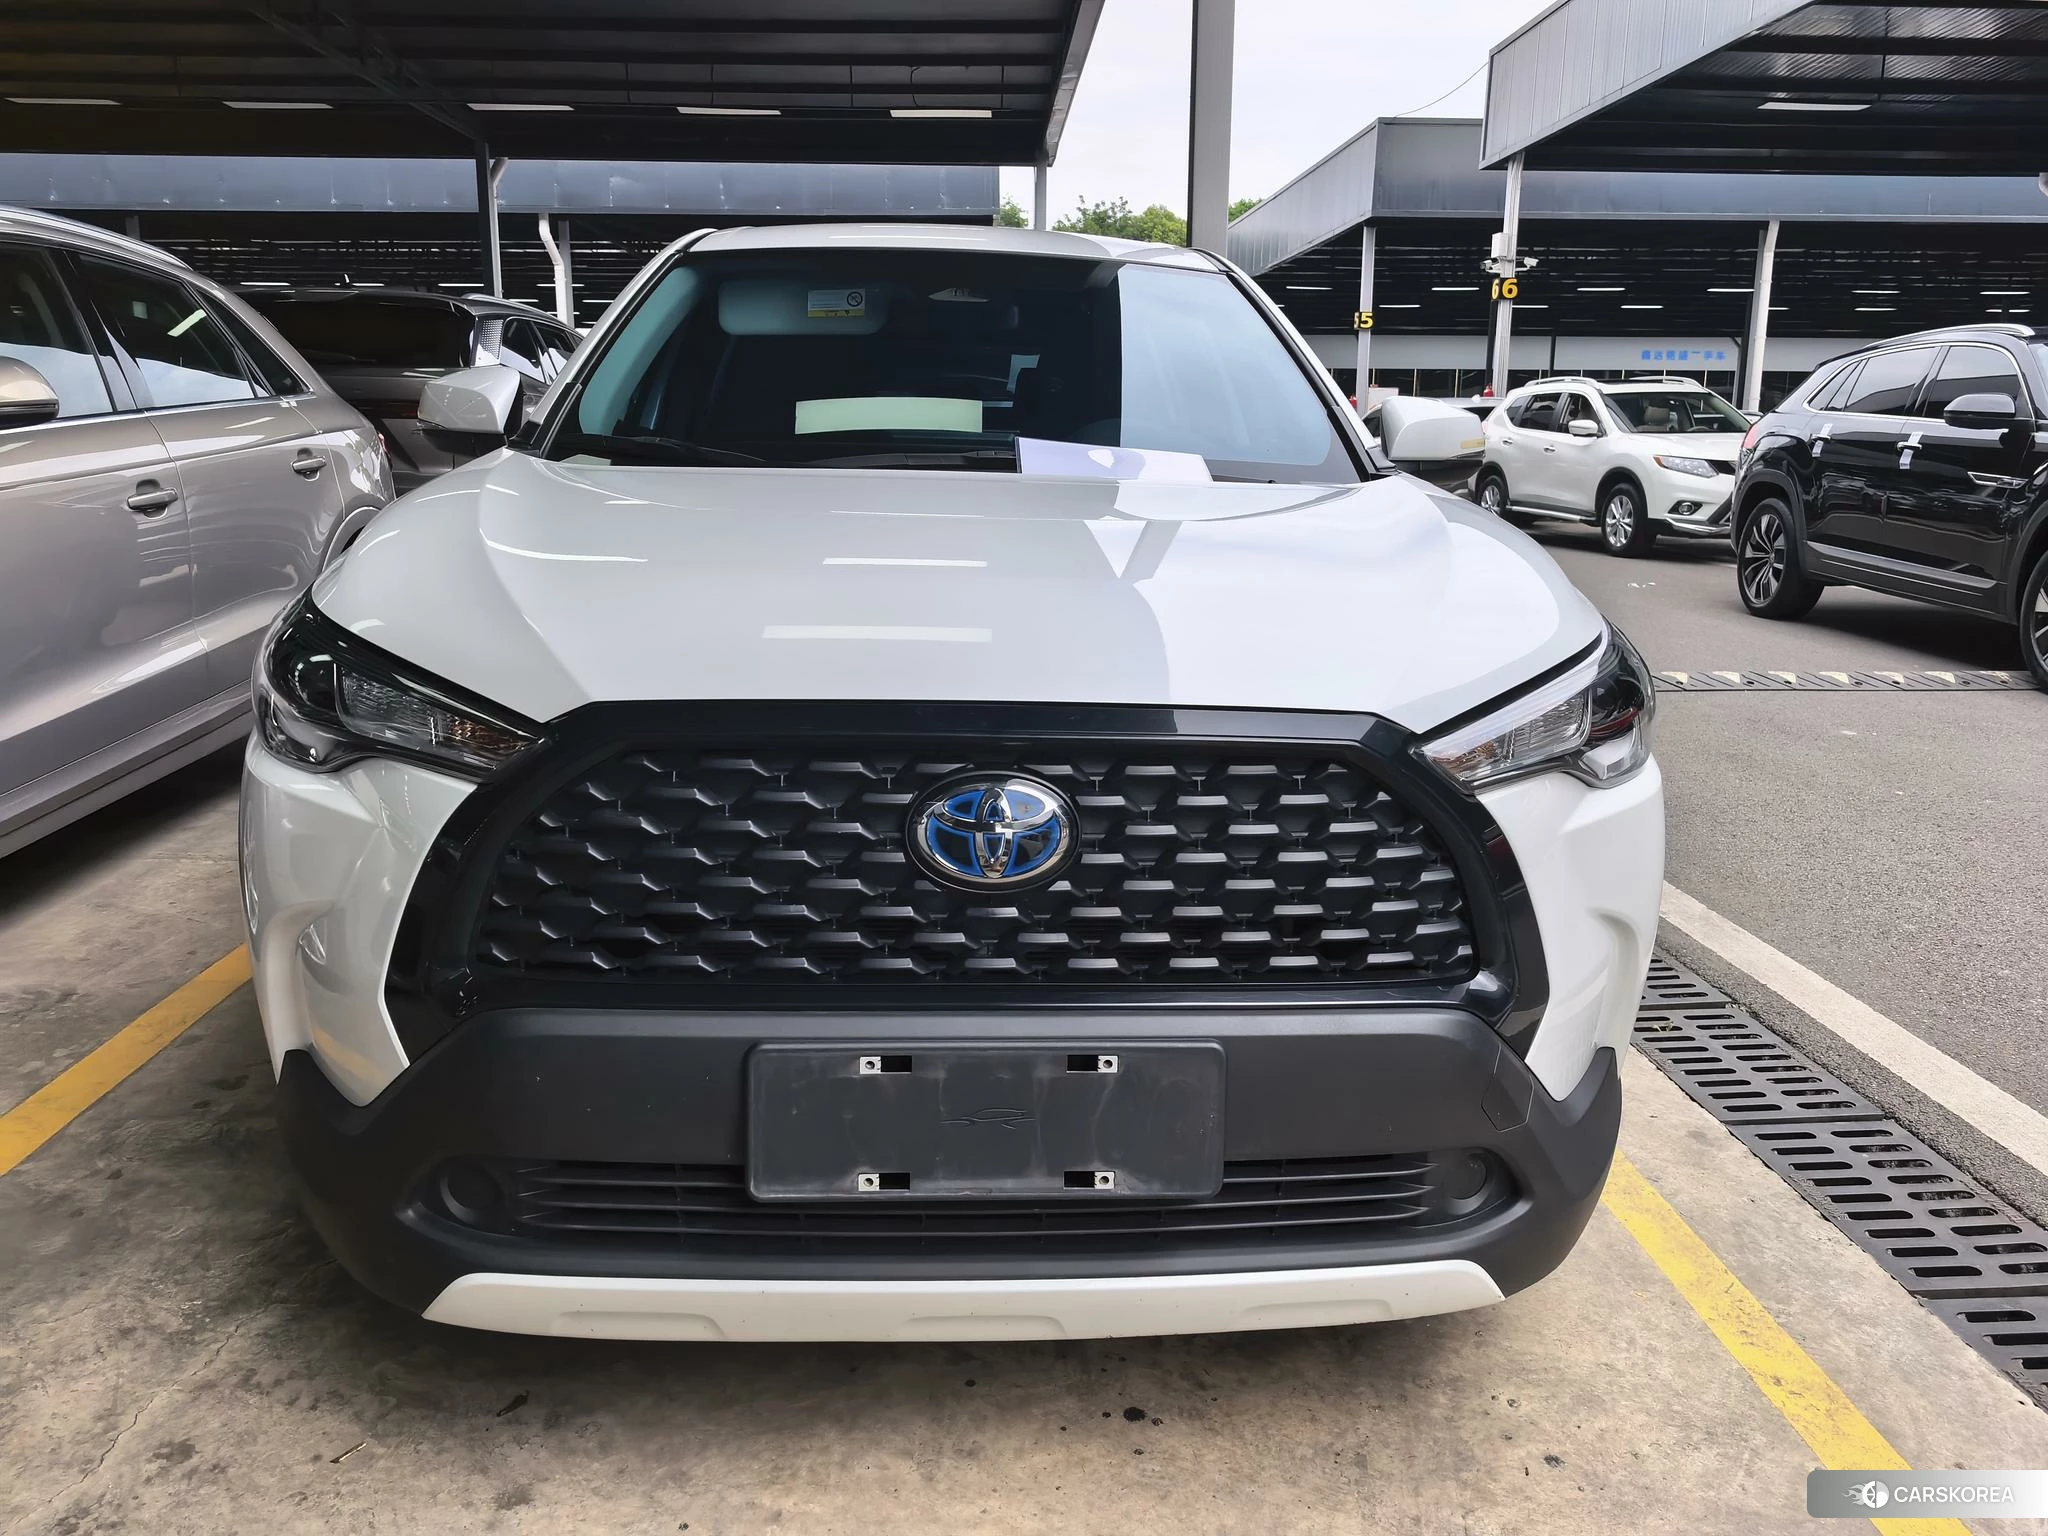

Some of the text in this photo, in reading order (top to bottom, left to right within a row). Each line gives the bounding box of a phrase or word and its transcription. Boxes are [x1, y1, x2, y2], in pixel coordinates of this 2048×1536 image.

[1491, 279, 1499, 300] 6
[1502, 278, 1518, 299] 6
[1360, 312, 1373, 328] 5
